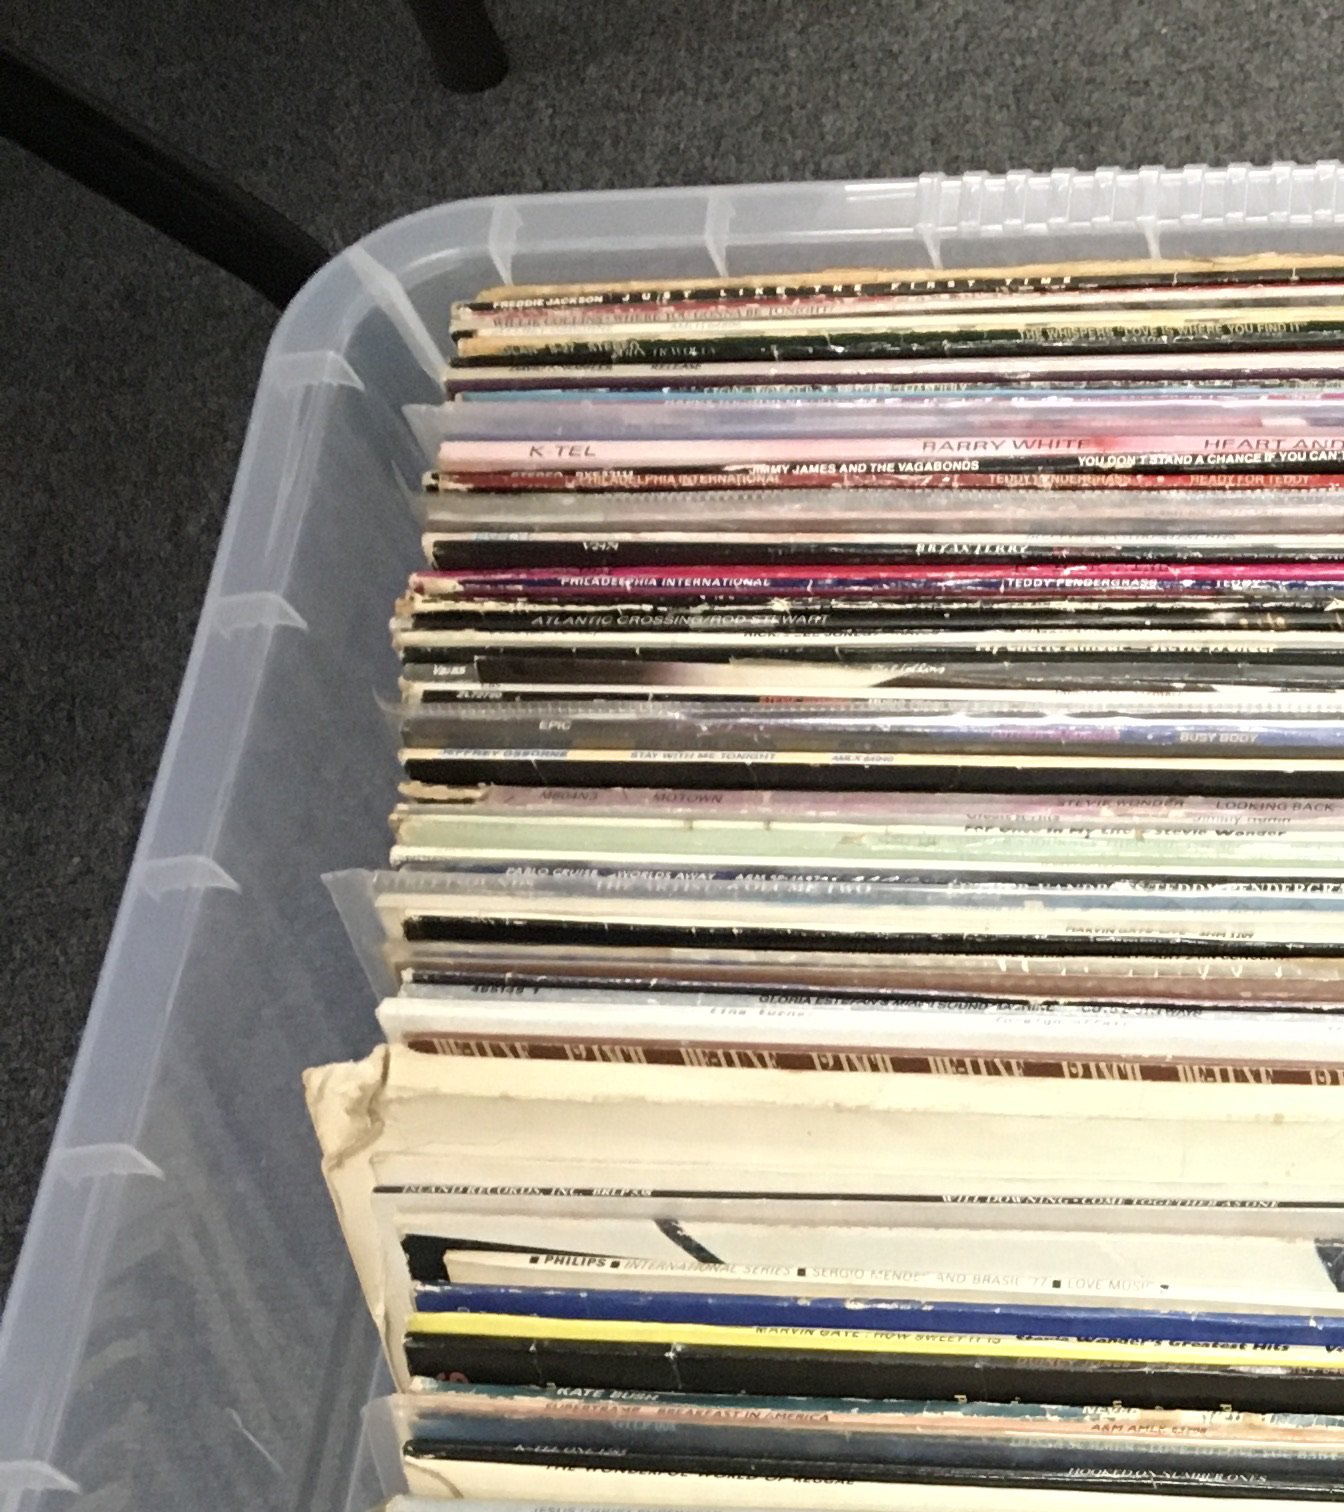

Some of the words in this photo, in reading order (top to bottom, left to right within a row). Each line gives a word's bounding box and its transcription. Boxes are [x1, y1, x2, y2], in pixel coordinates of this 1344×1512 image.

[493, 298, 544, 309] FREDDIE
[546, 295, 603, 305] JACKSON
[892, 280, 976, 290] FIRST
[1005, 276, 1072, 284] TIME
[751, 464, 789, 474] JIMMY
[793, 464, 836, 473] JAMES
[839, 463, 867, 472] AND
[871, 462, 895, 472] THE
[897, 460, 979, 472] VAGABONDS
[1078, 456, 1105, 467] YOU
[1150, 454, 1192, 465] STAND
[1195, 454, 1205, 464] A
[1207, 453, 1261, 464] CHANCE
[1264, 453, 1275, 463] IF
[1278, 451, 1306, 462] YOU
[561, 577, 656, 586] PHILADELPHIA
[662, 577, 770, 587] INTERNATIONAL
[1008, 578, 1051, 588] TEDDY
[1056, 578, 1157, 587] PENDERGRASS
[531, 616, 611, 625] ATLANTIC
[751, 615, 828, 625] STEWART
[539, 719, 571, 730] EPIC
[653, 793, 723, 804] MOTOWN
[1216, 801, 1287, 811] LOOKING
[1292, 802, 1334, 812] BACK
[506, 867, 549, 877] PABLO
[553, 868, 598, 879] CRUISE
[544, 1255, 607, 1268] PHILIPS
[935, 1272, 969, 1284] AND
[1067, 1278, 1104, 1290] LOVE
[556, 1386, 607, 1396] KATE
